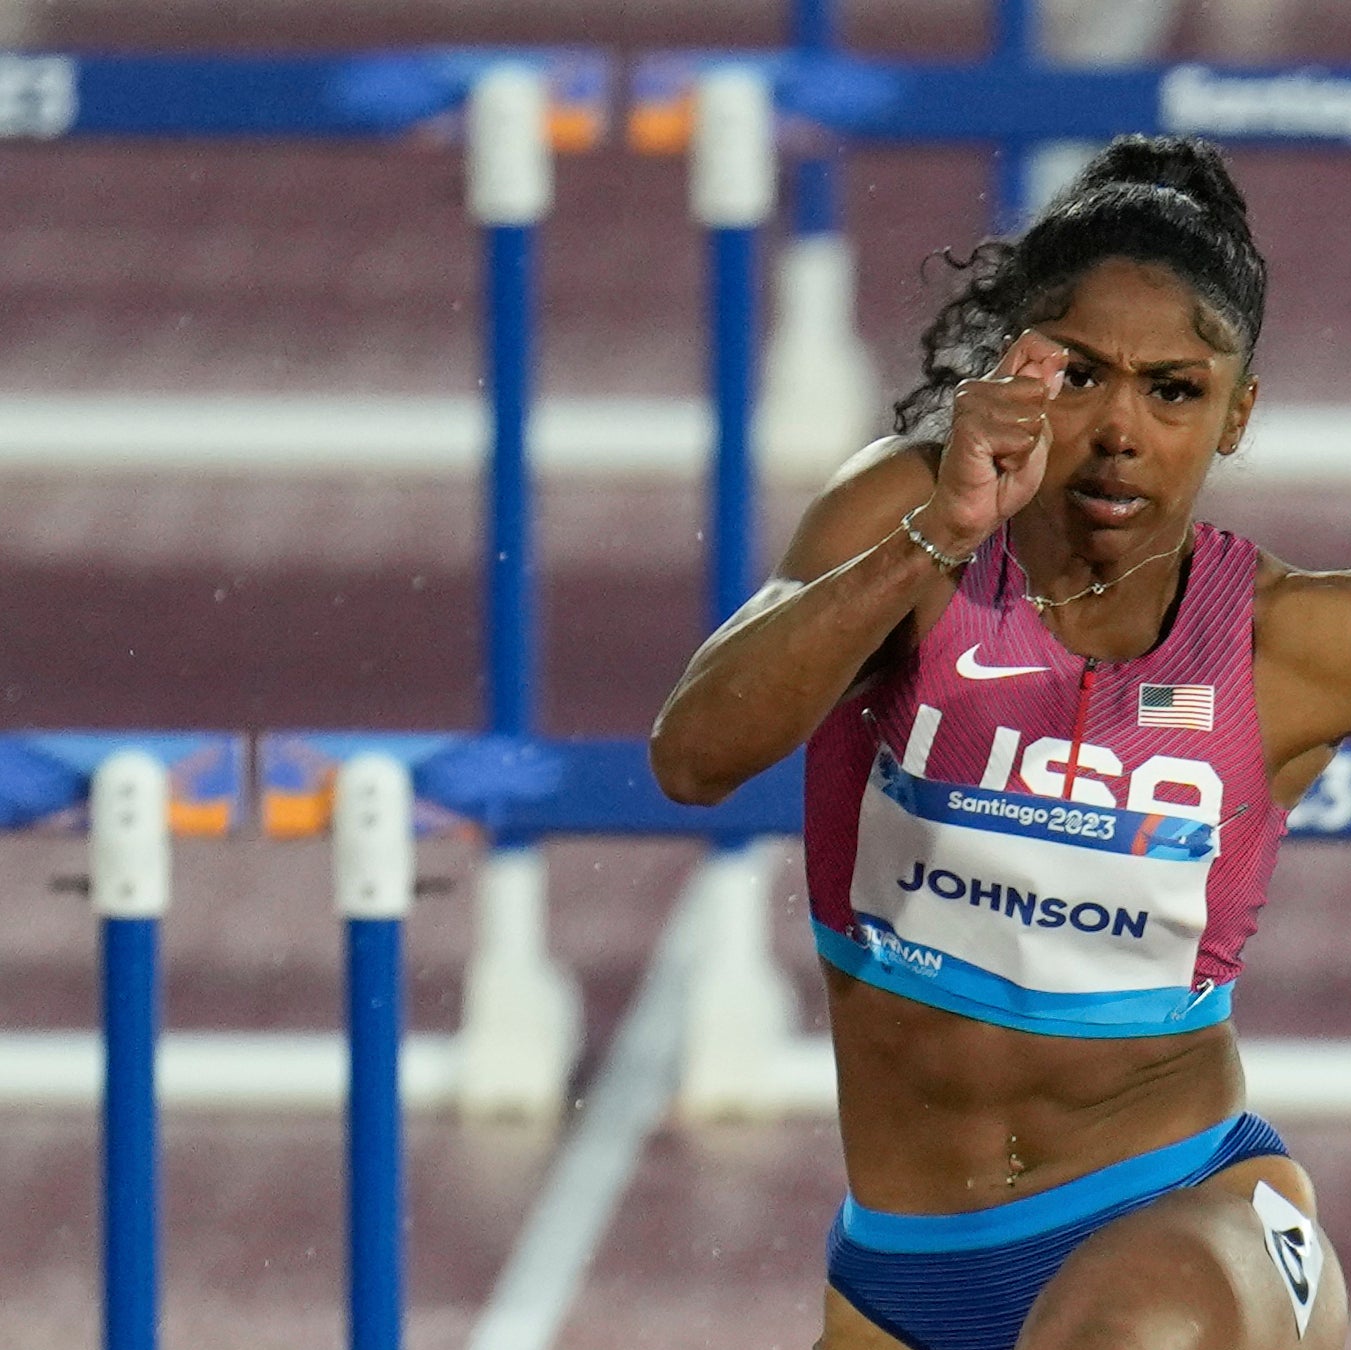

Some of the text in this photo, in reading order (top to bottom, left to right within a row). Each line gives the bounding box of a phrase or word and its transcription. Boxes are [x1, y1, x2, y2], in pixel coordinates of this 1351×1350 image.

[947, 791, 1117, 840] Santiago 2023
[897, 862, 1148, 938] JOHNSON
